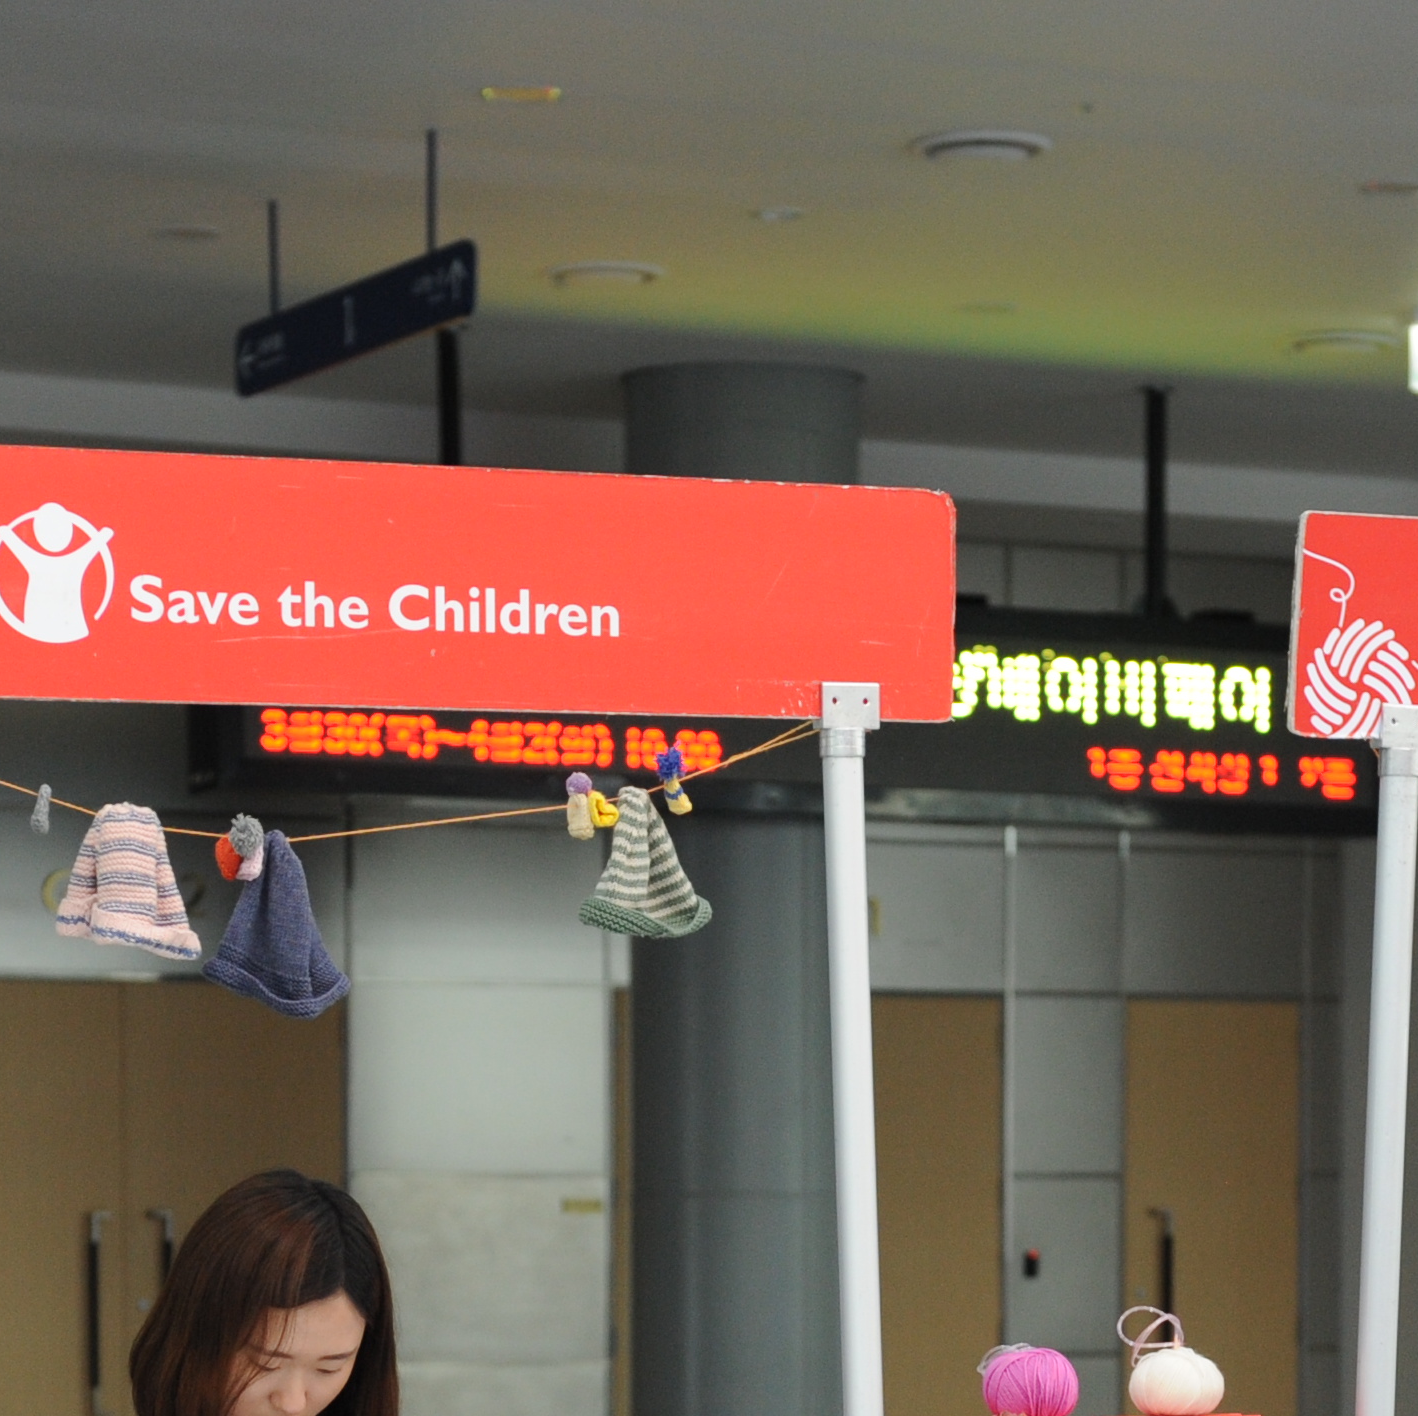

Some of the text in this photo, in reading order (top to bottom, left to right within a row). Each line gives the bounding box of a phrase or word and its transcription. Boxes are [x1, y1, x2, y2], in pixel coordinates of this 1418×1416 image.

[129, 574, 620, 638] Save the Children
[626, 727, 722, 772] 1000
